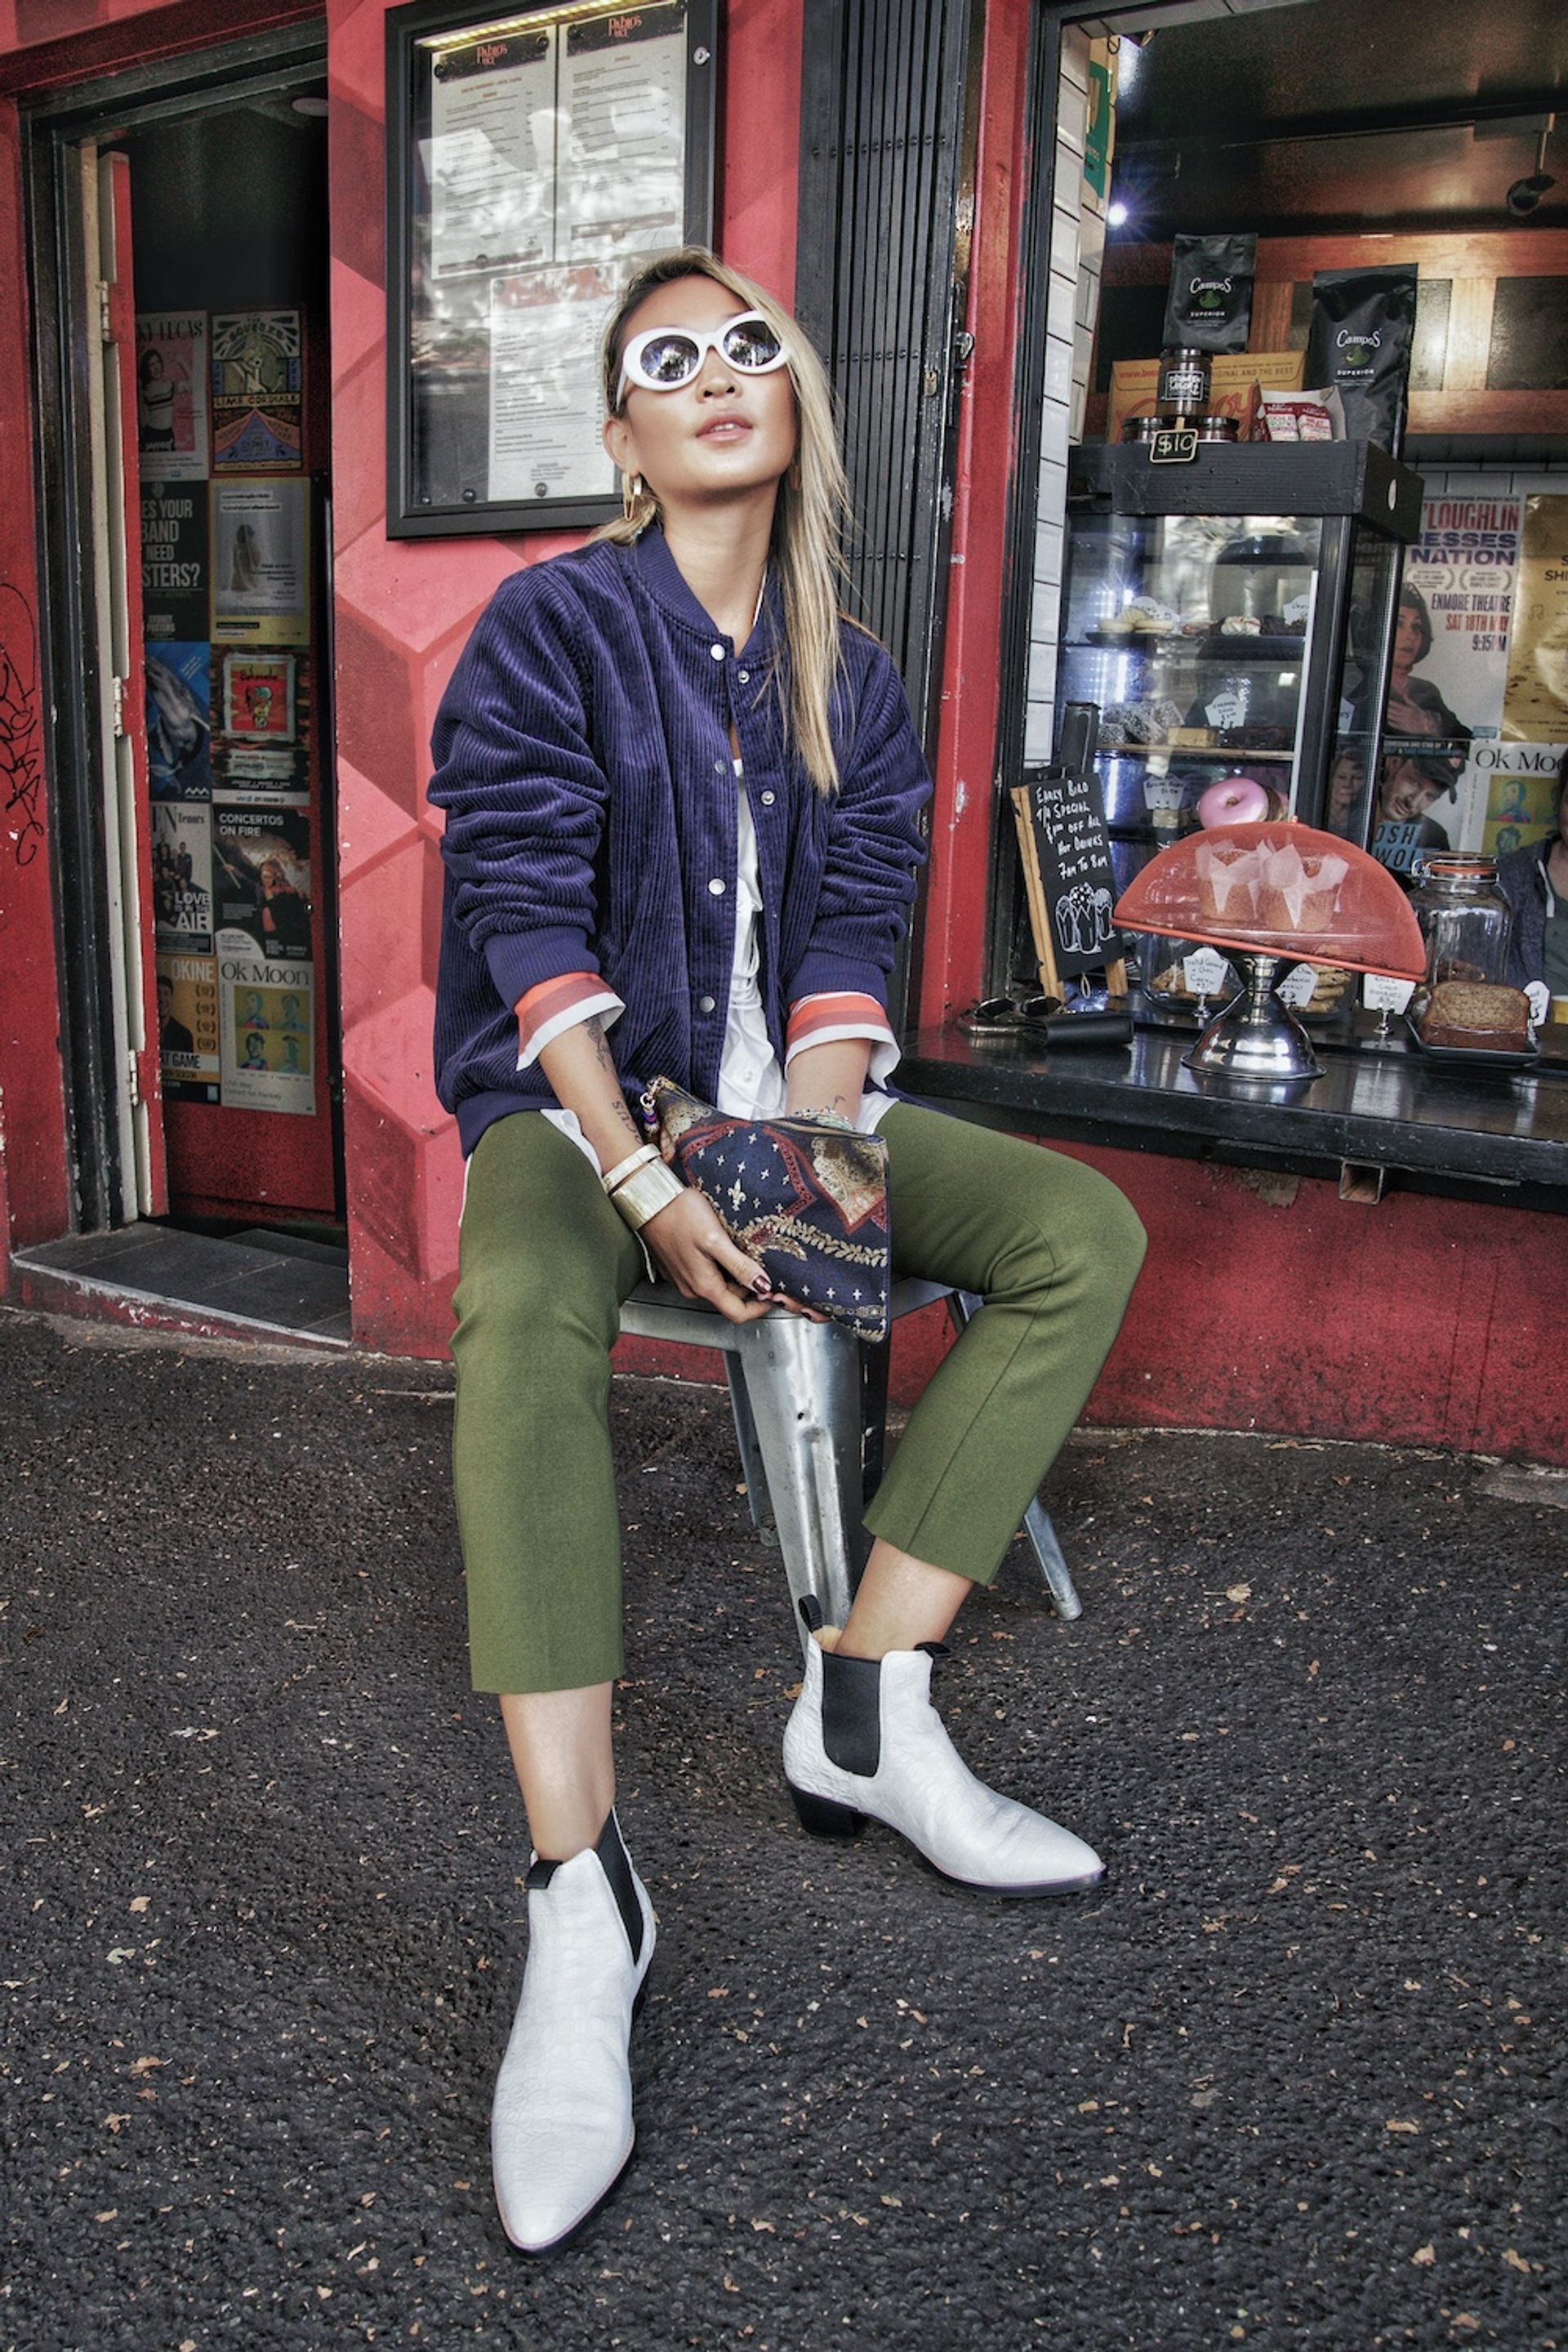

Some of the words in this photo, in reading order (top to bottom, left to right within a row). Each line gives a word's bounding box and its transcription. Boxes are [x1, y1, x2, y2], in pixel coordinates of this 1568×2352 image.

[1241, 368, 1257, 376] AND
[1259, 368, 1272, 376] THE
[1275, 367, 1294, 375] BEST
[1157, 434, 1194, 456] $10
[160, 498, 193, 519] YOUR
[141, 520, 180, 543] BAND
[146, 544, 175, 561] NEED
[1411, 549, 1516, 566] NATION
[1432, 594, 1469, 612] ENMORE
[1472, 595, 1512, 613] THEATRE
[1446, 613, 1462, 632] SAT
[1475, 748, 1510, 769] Ok
[1054, 800, 1091, 819] SPECIAL
[177, 813, 205, 825] Tenors
[219, 813, 284, 827] CONCERTOS
[1067, 819, 1085, 833] OFF
[219, 826, 236, 836] ON
[238, 827, 261, 837] FIRE
[1074, 833, 1103, 851] DRINKS
[175, 893, 210, 905] LOVE
[176, 911, 210, 931] AIR
[170, 959, 215, 983] OKINE
[221, 961, 248, 982] Ok
[252, 964, 310, 987] Moon
[172, 1054, 201, 1069] GAME
